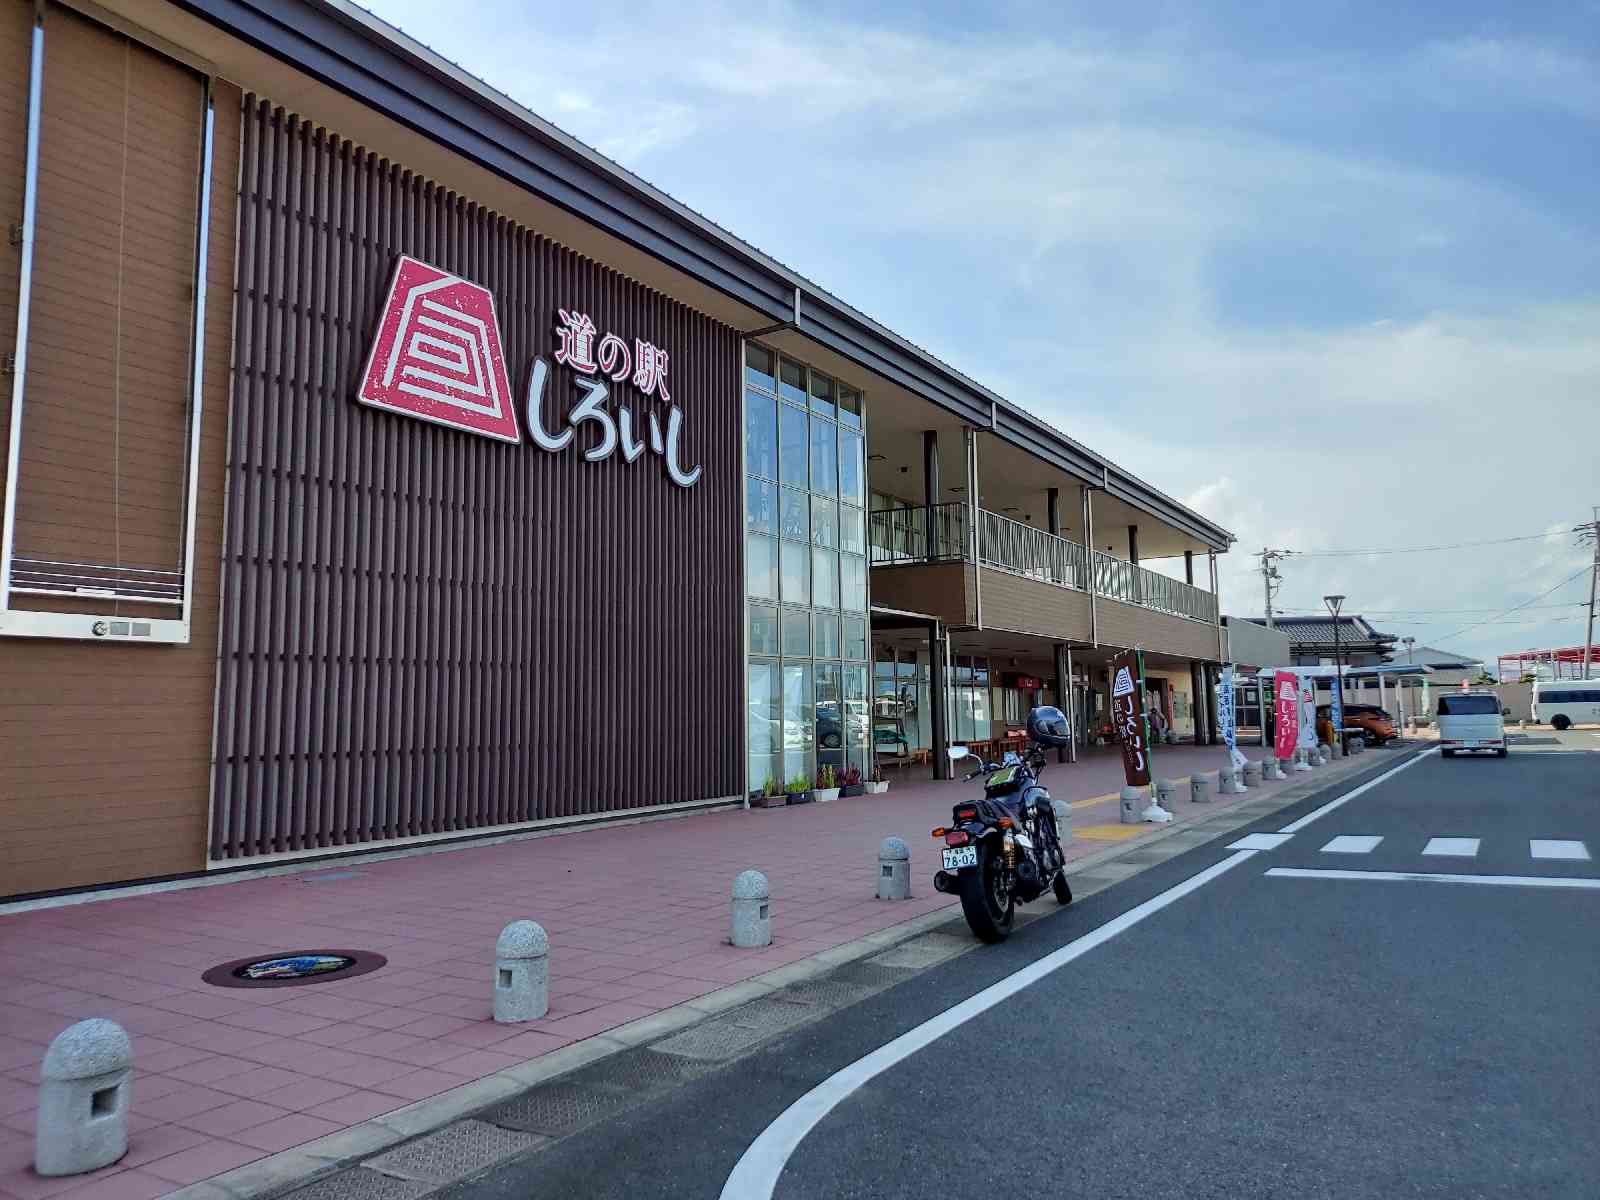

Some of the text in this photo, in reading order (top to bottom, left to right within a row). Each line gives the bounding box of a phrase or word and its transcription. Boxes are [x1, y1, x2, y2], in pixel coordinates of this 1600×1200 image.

[556, 308, 670, 401] 道の駅
[528, 356, 702, 487] しろいし
